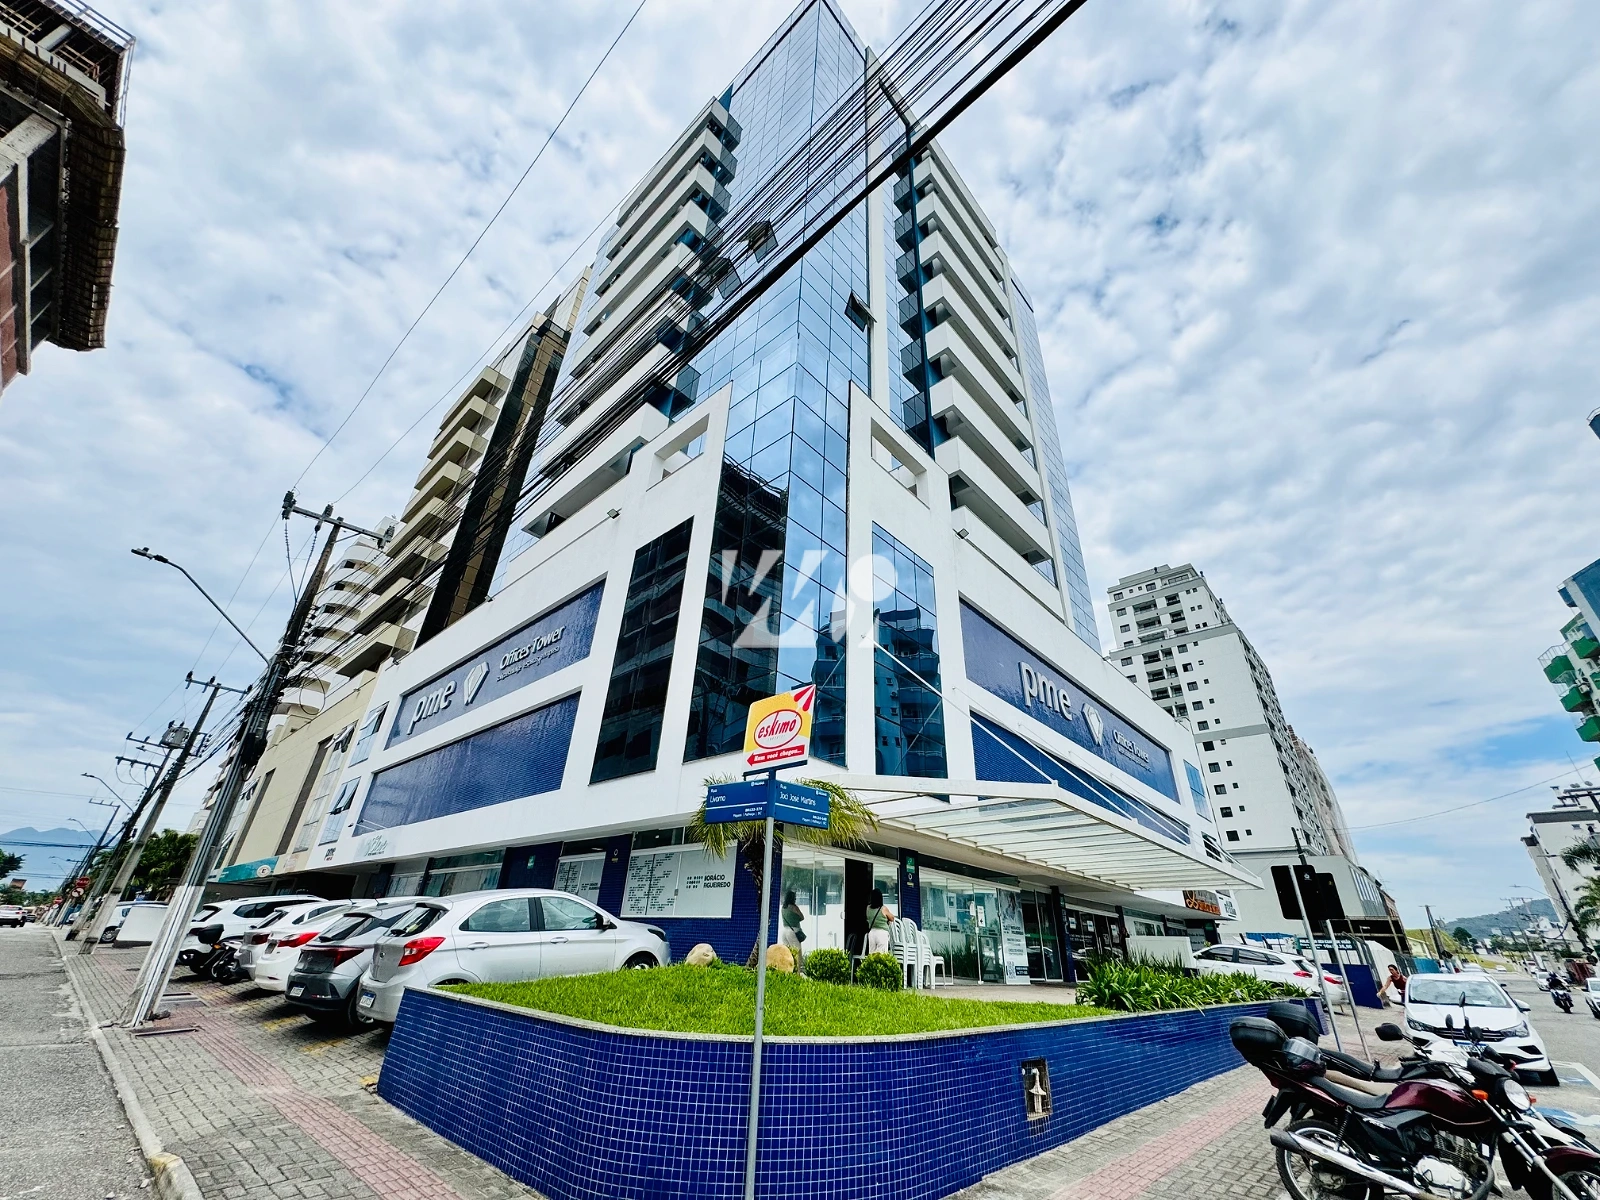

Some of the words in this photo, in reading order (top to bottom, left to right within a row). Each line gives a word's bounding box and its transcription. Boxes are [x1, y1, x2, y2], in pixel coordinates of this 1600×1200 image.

[499, 644, 531, 671] Offices
[530, 626, 566, 653] Tower
[406, 680, 457, 735] pme
[1017, 661, 1073, 721] pme
